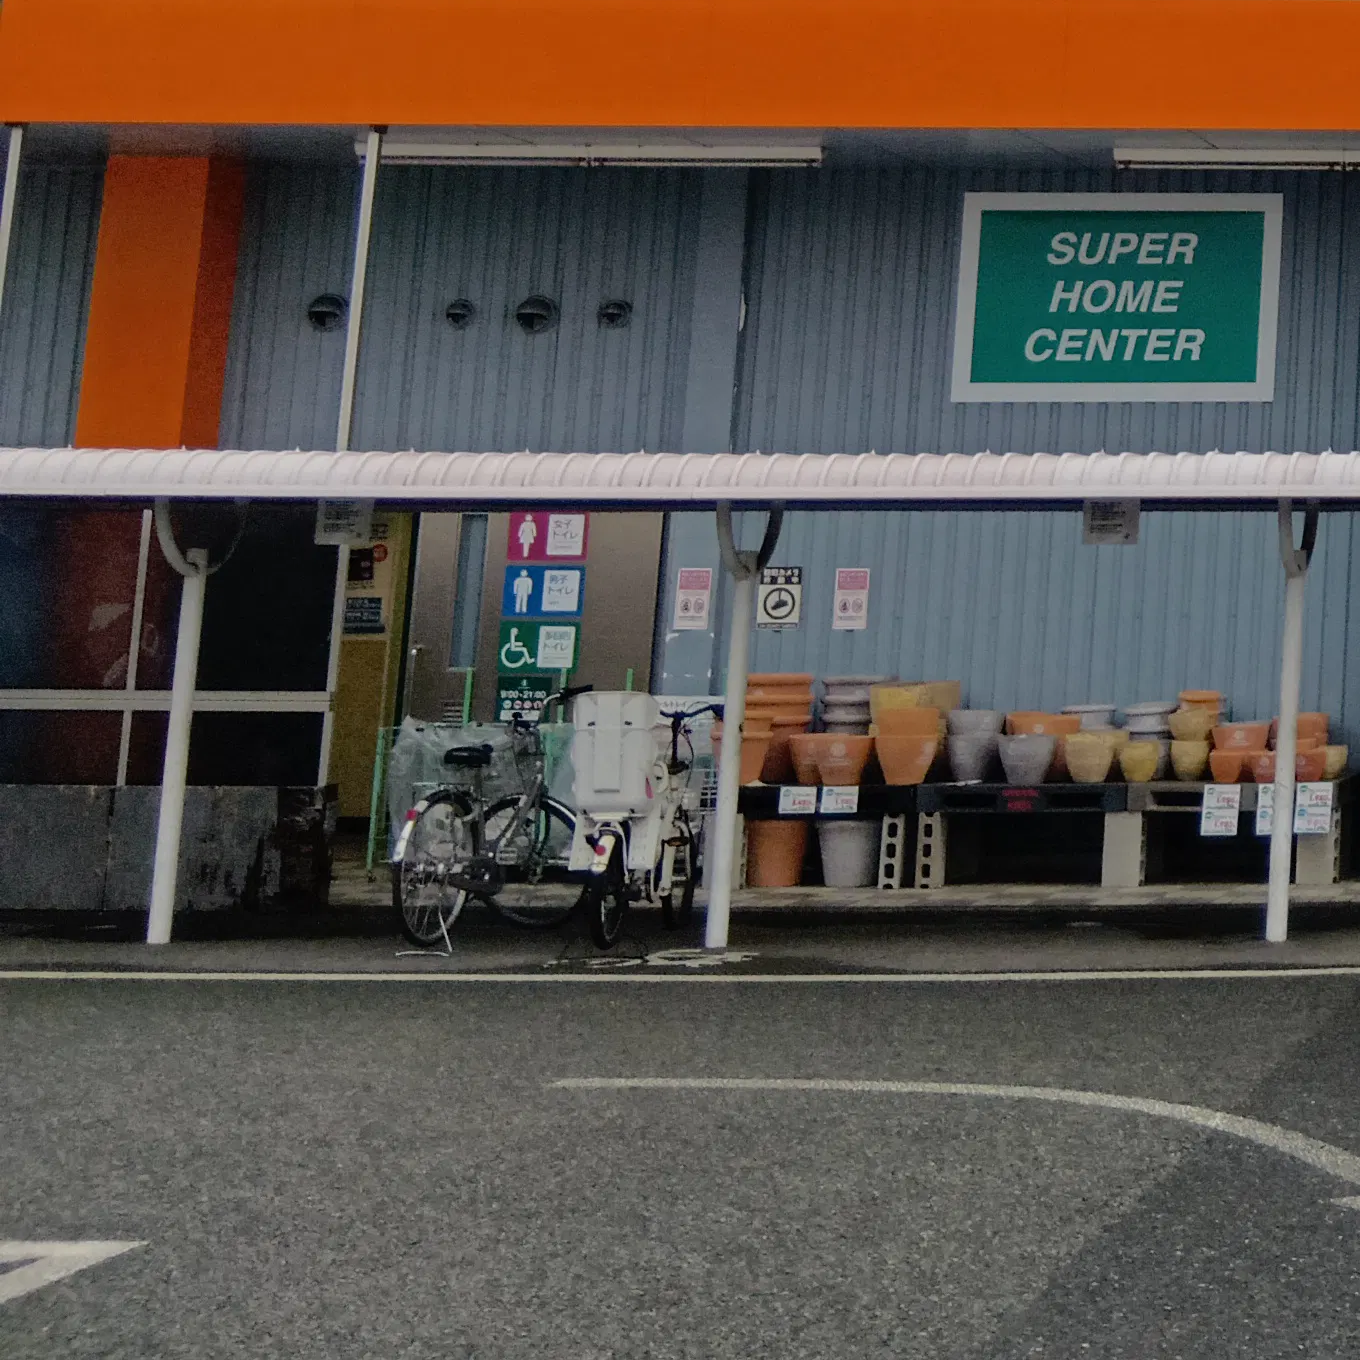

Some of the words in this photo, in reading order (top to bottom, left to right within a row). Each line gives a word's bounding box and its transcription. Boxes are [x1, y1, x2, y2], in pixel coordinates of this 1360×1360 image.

[1046, 231, 1200, 266] SUPER
[1048, 279, 1184, 314] HOME
[1024, 328, 1206, 363] CENTER
